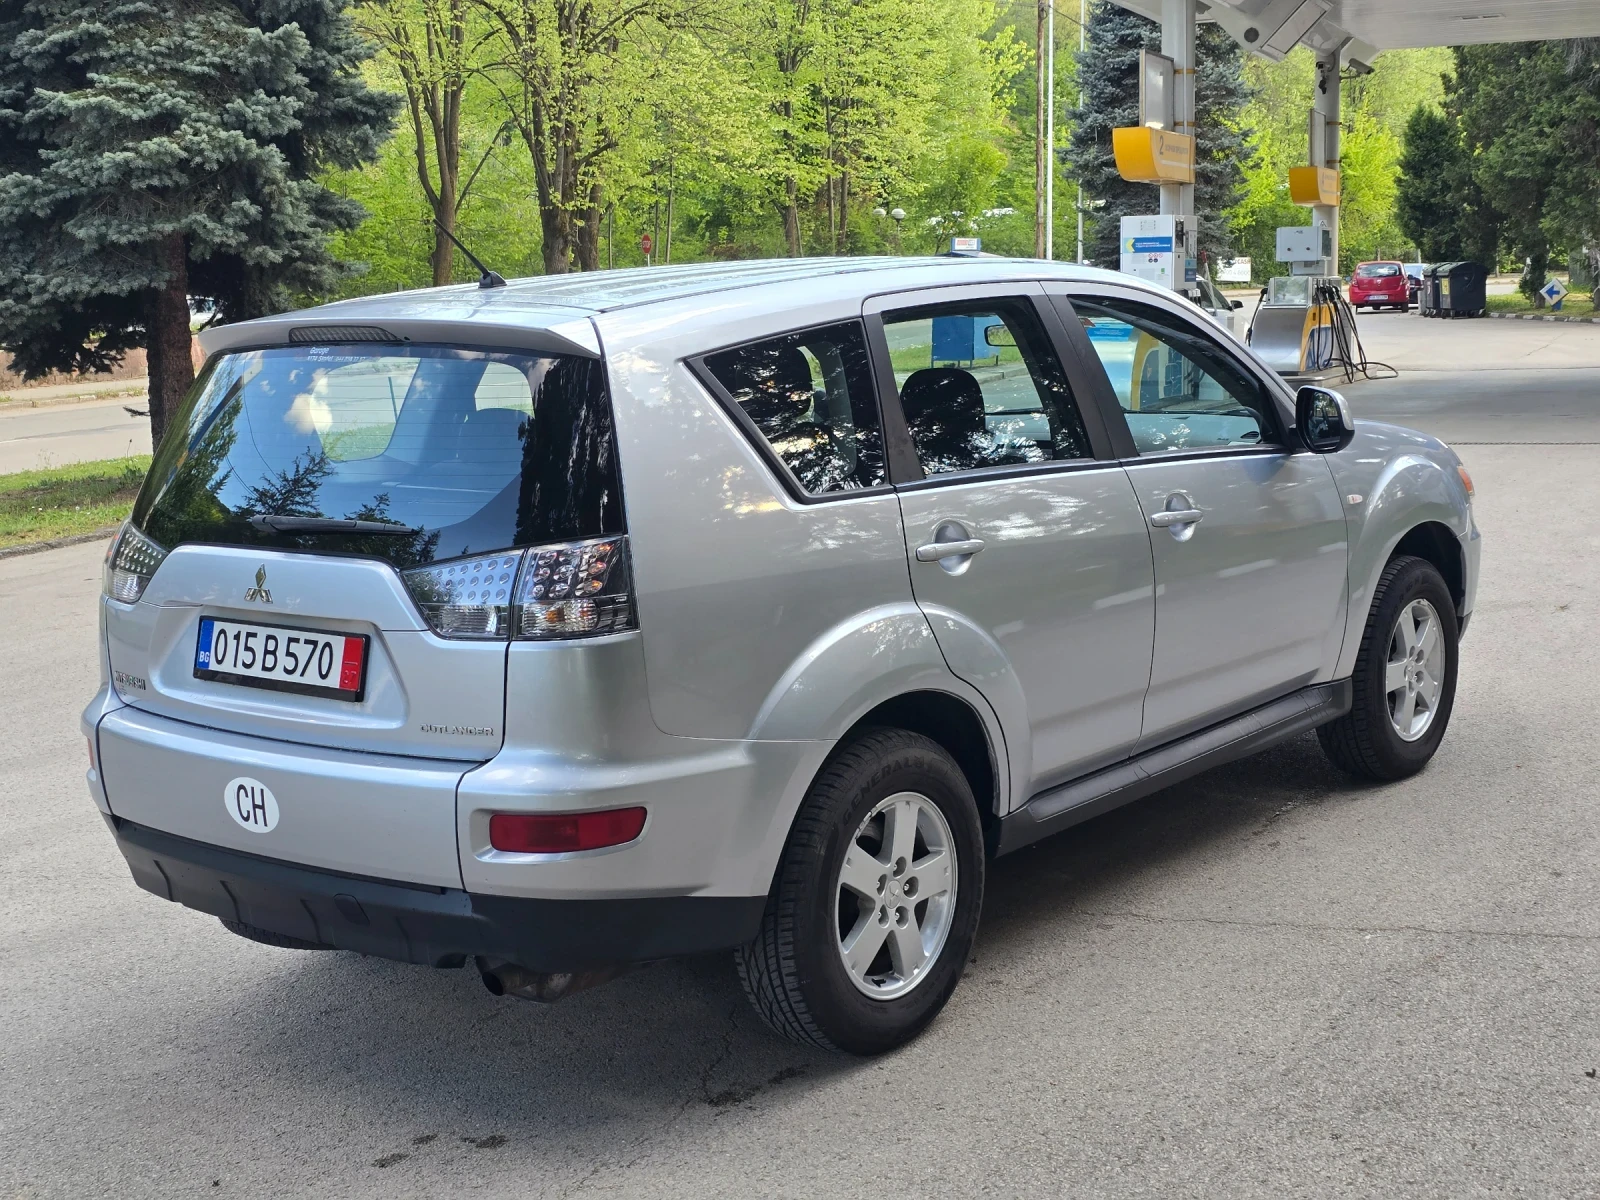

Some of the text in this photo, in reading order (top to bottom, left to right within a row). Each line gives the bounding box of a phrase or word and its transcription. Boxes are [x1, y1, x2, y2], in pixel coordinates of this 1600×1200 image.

[310, 347, 329, 355] Garage
[199, 651, 210, 663] BG
[420, 723, 494, 736] OUTLANDER
[842, 756, 914, 826] GENERAL
[236, 783, 269, 828] CH
